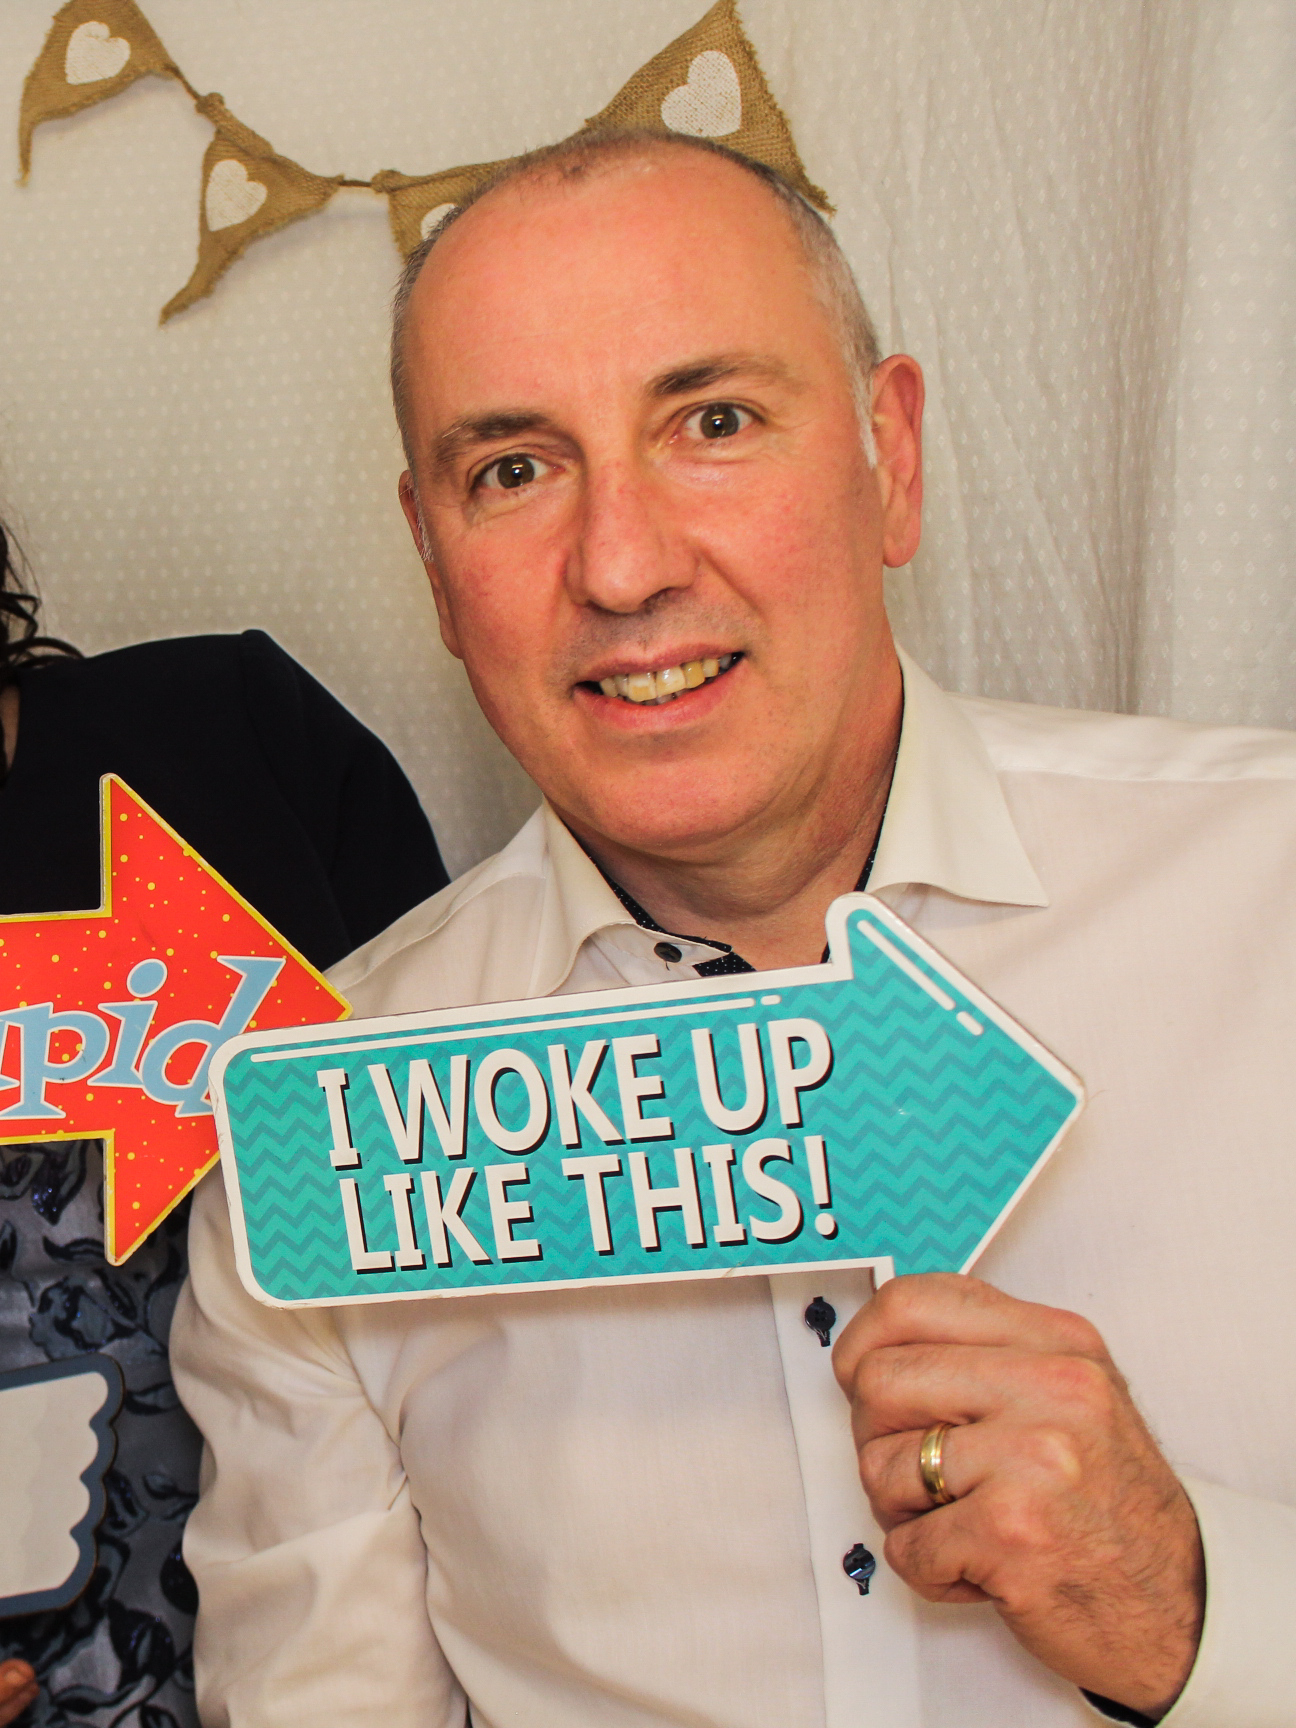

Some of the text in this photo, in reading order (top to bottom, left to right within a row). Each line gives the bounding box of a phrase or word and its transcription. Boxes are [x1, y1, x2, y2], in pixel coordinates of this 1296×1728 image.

[316, 1017, 834, 1170] I WOKE UP
[338, 1134, 839, 1274] LIKE THIS!
